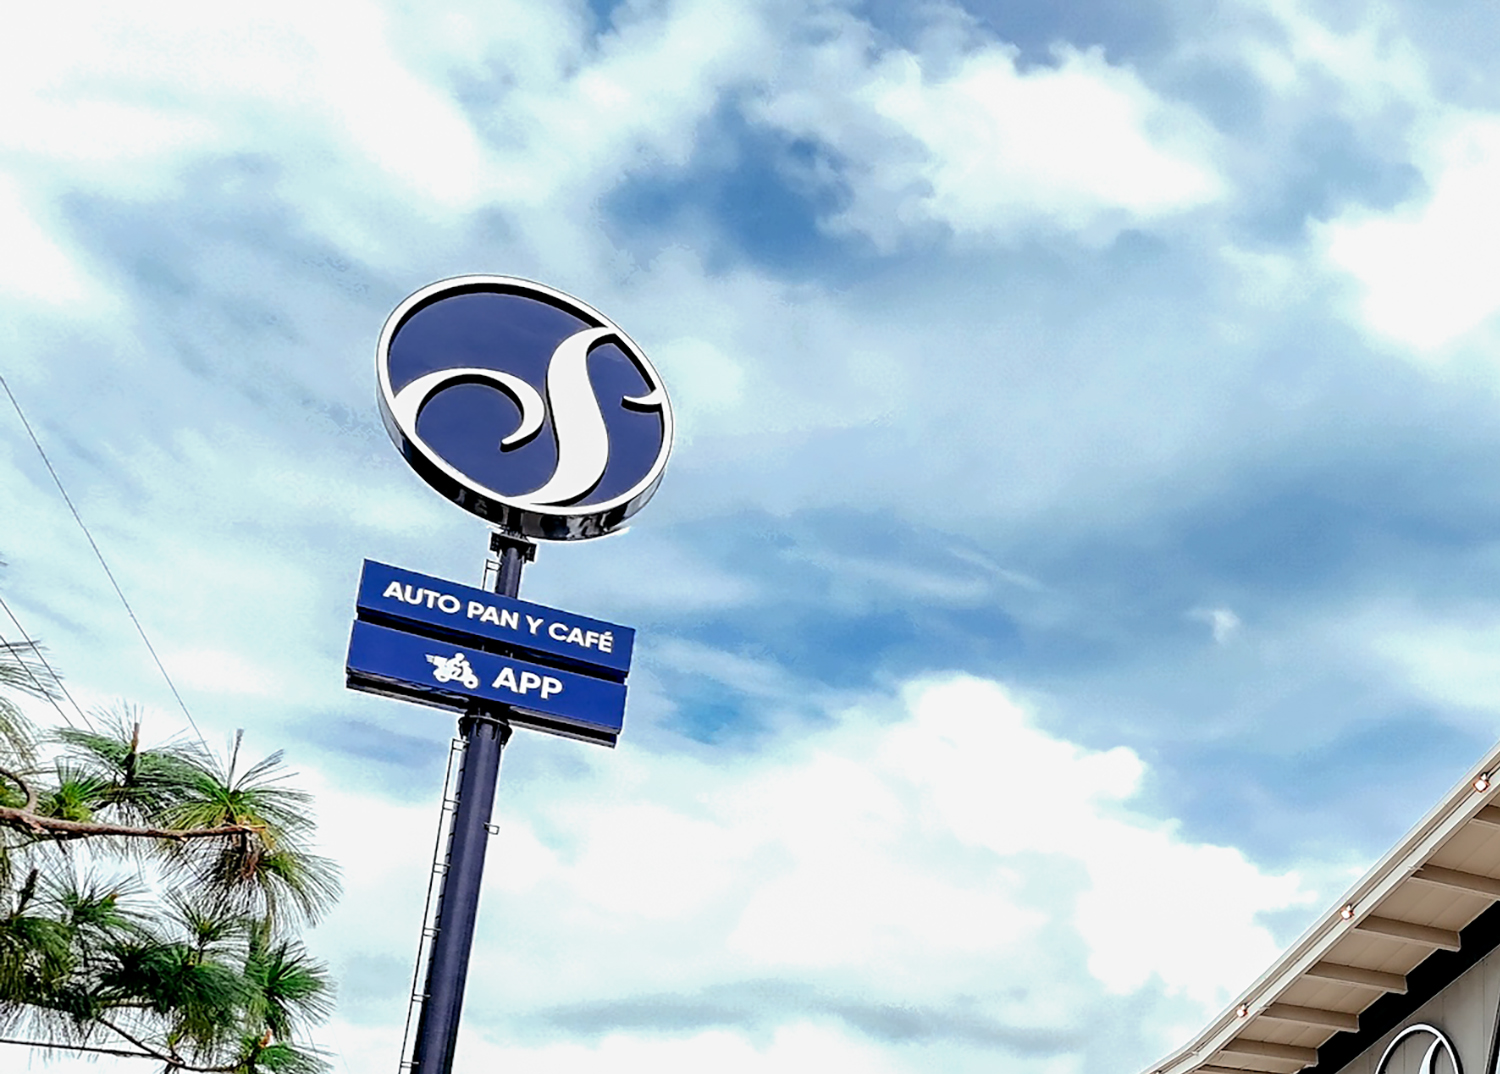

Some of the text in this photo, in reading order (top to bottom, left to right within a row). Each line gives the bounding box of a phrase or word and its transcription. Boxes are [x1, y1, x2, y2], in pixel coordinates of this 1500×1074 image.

[383, 580, 614, 654] AUTO PAN Y CAFÉ
[492, 667, 563, 701] APP
